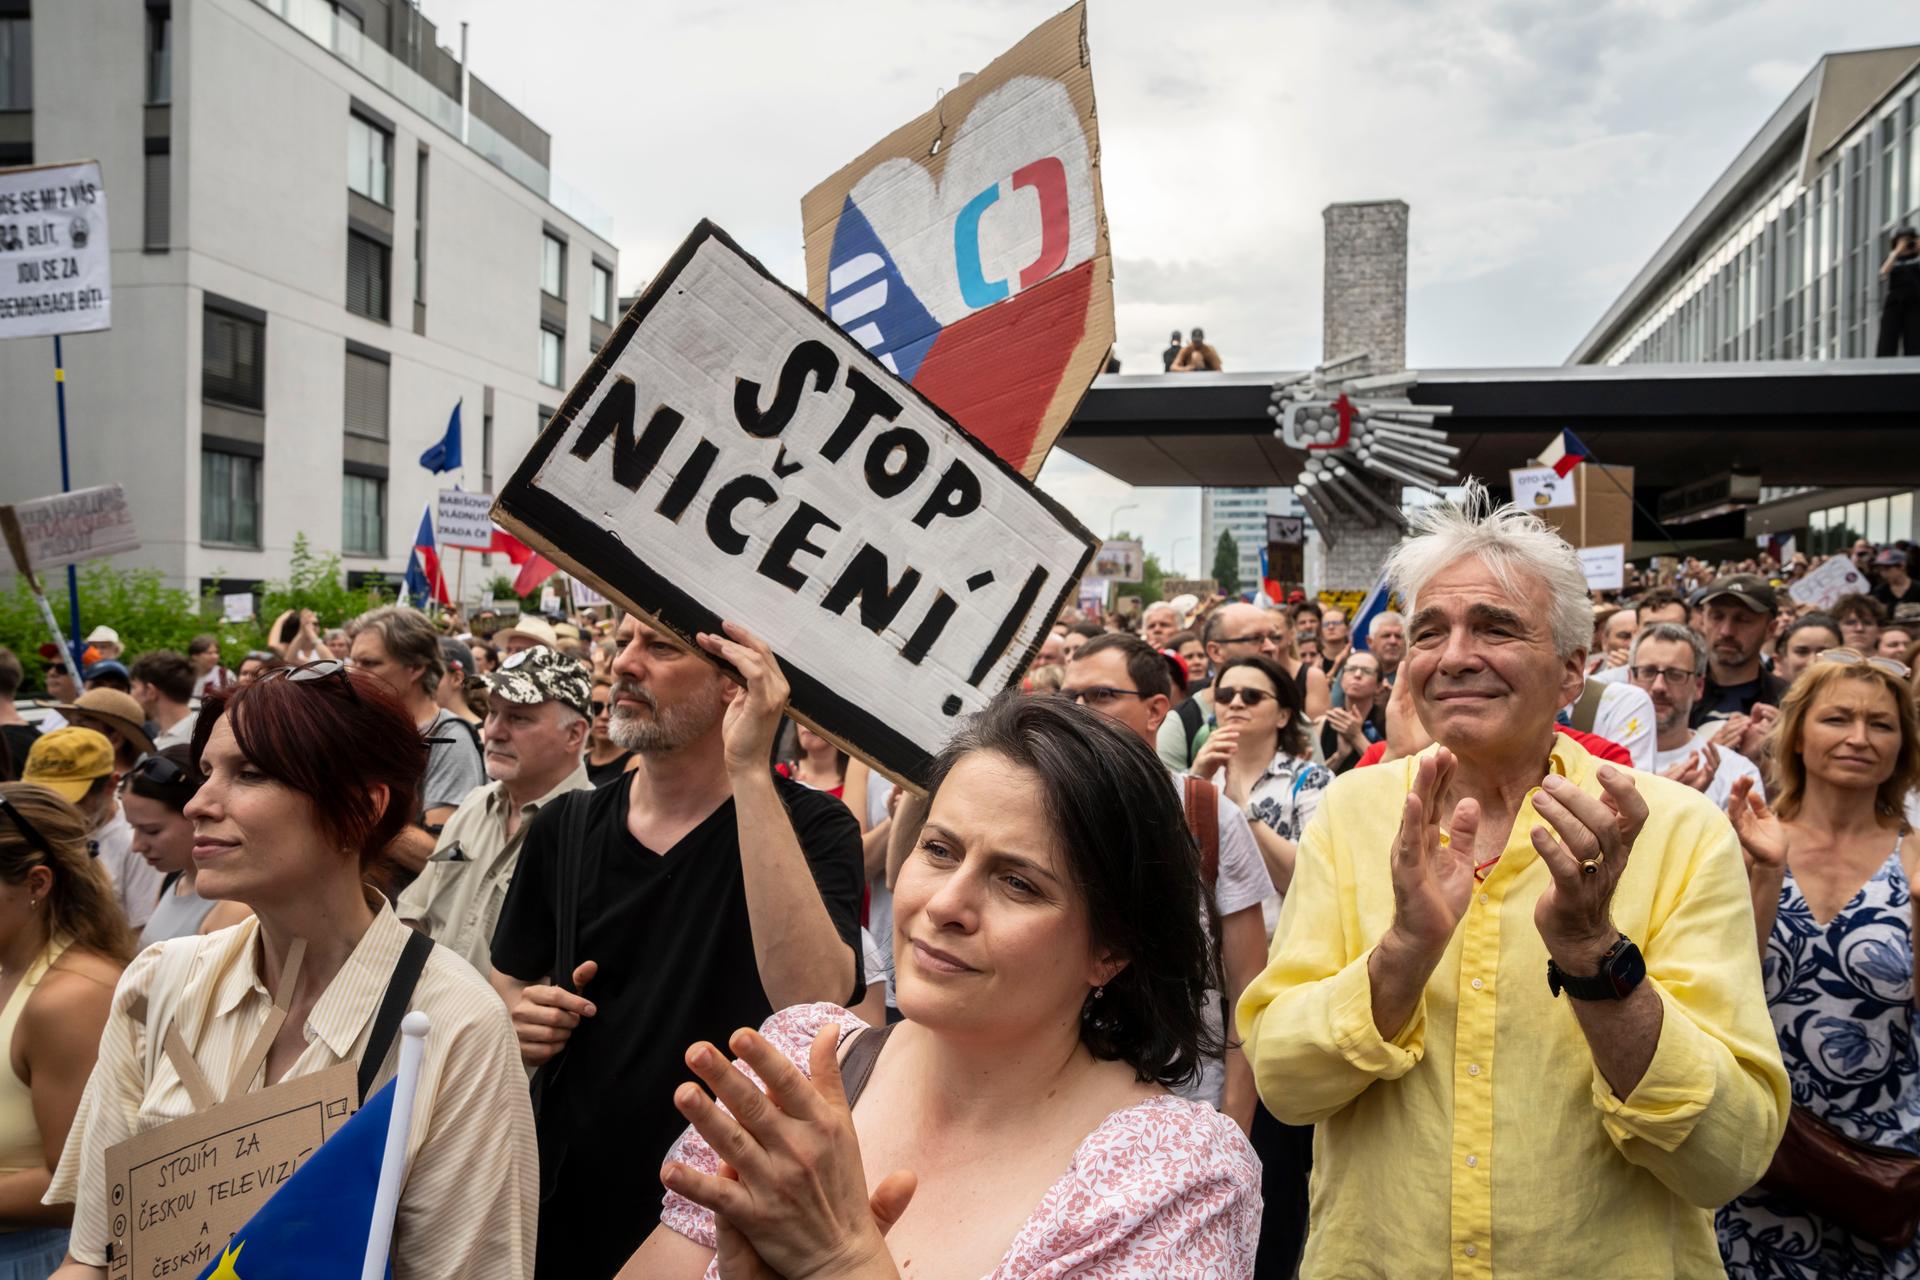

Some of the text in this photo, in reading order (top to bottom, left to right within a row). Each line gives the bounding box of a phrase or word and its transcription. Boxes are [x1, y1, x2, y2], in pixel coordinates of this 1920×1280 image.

[21, 189, 39, 213] SE
[59, 186, 68, 208] Z
[70, 180, 96, 206] VÁS
[42, 258, 59, 282] SE
[61, 257, 79, 279] ZA
[734, 340, 982, 529] STOP
[437, 526, 471, 538] ZRADA
[569, 374, 1049, 716] NIČENÍ!
[158, 1133, 260, 1188] STOJÍM ZA
[138, 1190, 197, 1232] ČESKOU
[199, 1221, 209, 1236] A
[152, 1241, 211, 1279] ČESKÝM
